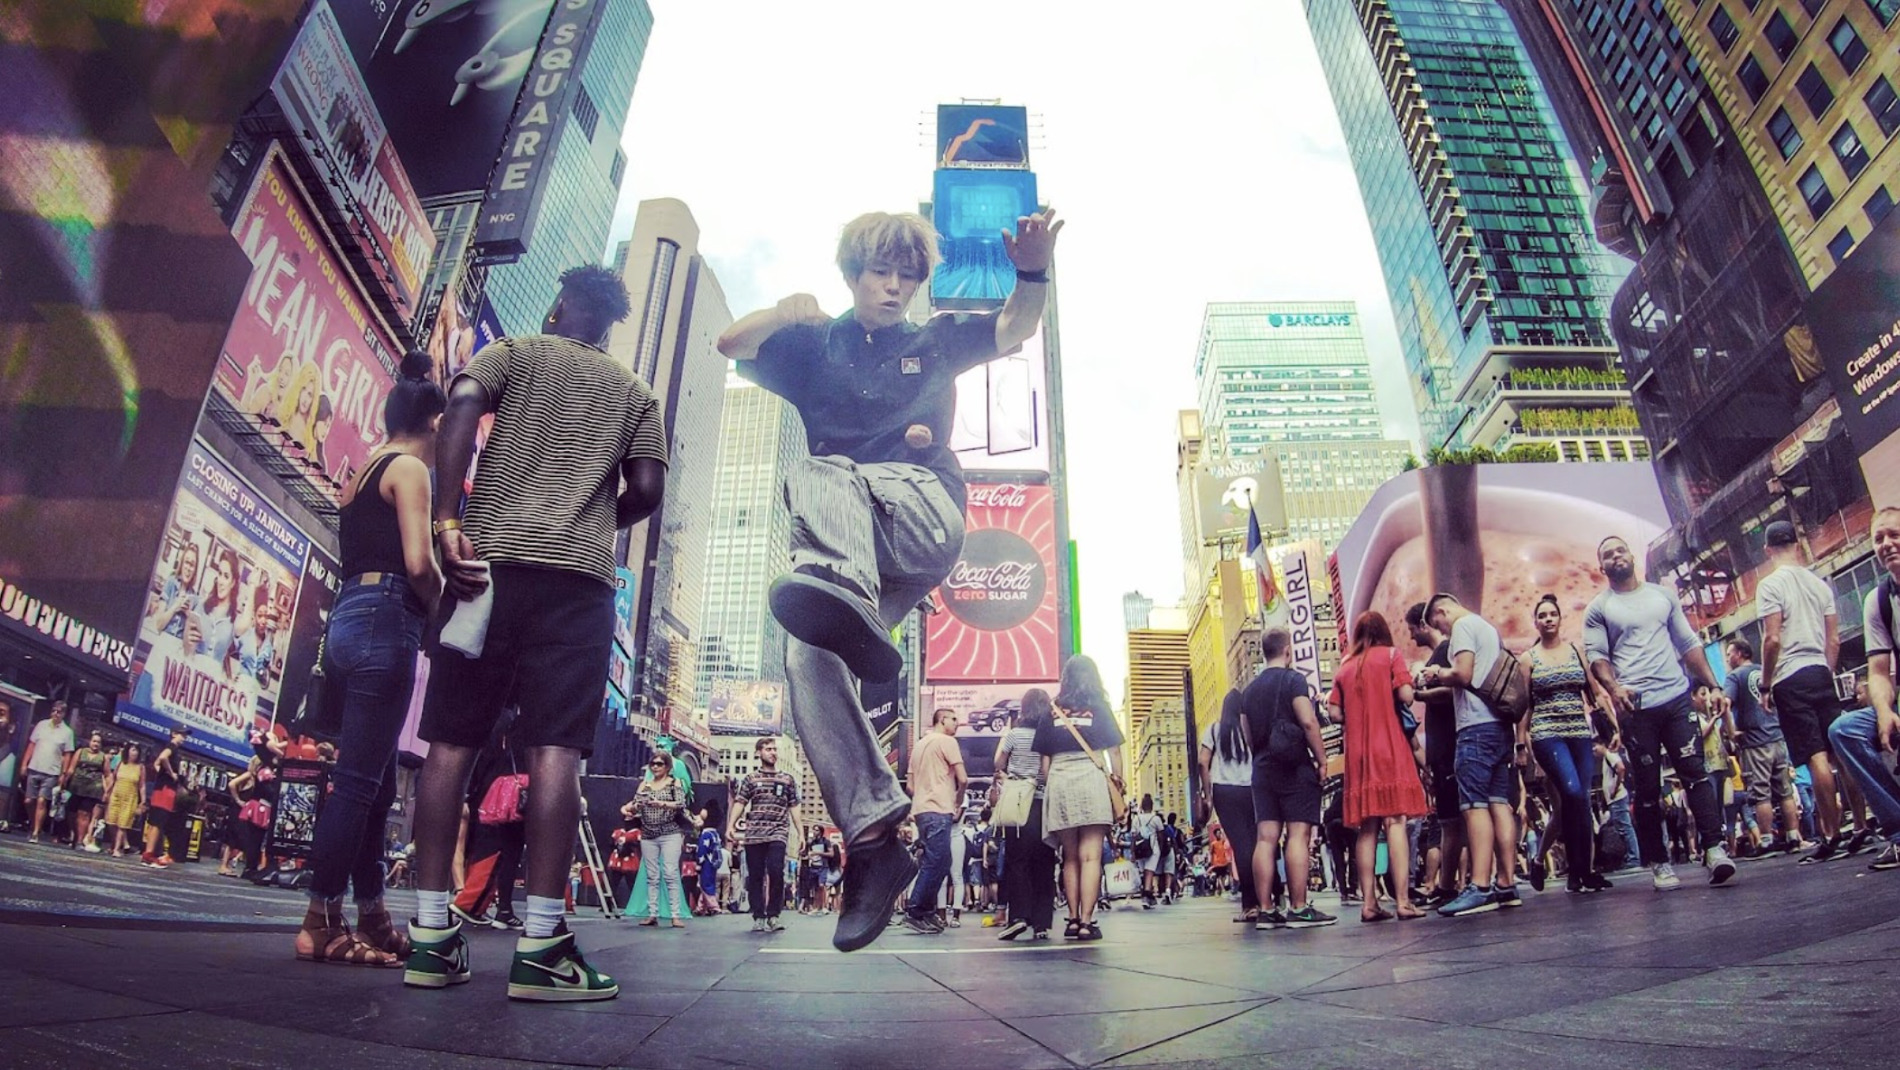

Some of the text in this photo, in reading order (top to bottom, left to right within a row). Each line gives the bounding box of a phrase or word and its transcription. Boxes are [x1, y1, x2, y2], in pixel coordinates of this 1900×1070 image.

[298, 43, 329, 111] WRONG
[500, 23, 578, 191] SQUARE
[361, 165, 409, 243] JERSEY
[404, 221, 434, 284] BOYS
[489, 213, 516, 224] NYC
[243, 216, 328, 362] MEAN
[265, 171, 395, 374] YOU KNOW YOU WANNA SIT WITH
[1285, 313, 1351, 326] BARCLAYS
[1846, 320, 1900, 377] Create in 4
[1853, 350, 1900, 396] Windows
[186, 471, 206, 490] LAST
[203, 486, 230, 513] CHANCE
[229, 506, 243, 523] FOR
[242, 518, 249, 527] A
[264, 534, 273, 545] OF
[192, 453, 239, 500] CLOSING
[240, 491, 256, 517] UP!
[255, 505, 298, 552] JANUARY
[296, 543, 304, 556] 5
[966, 484, 1030, 507] ca-Cola
[947, 561, 1037, 590] Coca-Cola
[954, 590, 1028, 600] zero SUGAR
[161, 655, 248, 730] WAITRESS
[867, 701, 893, 720] NGLOT
